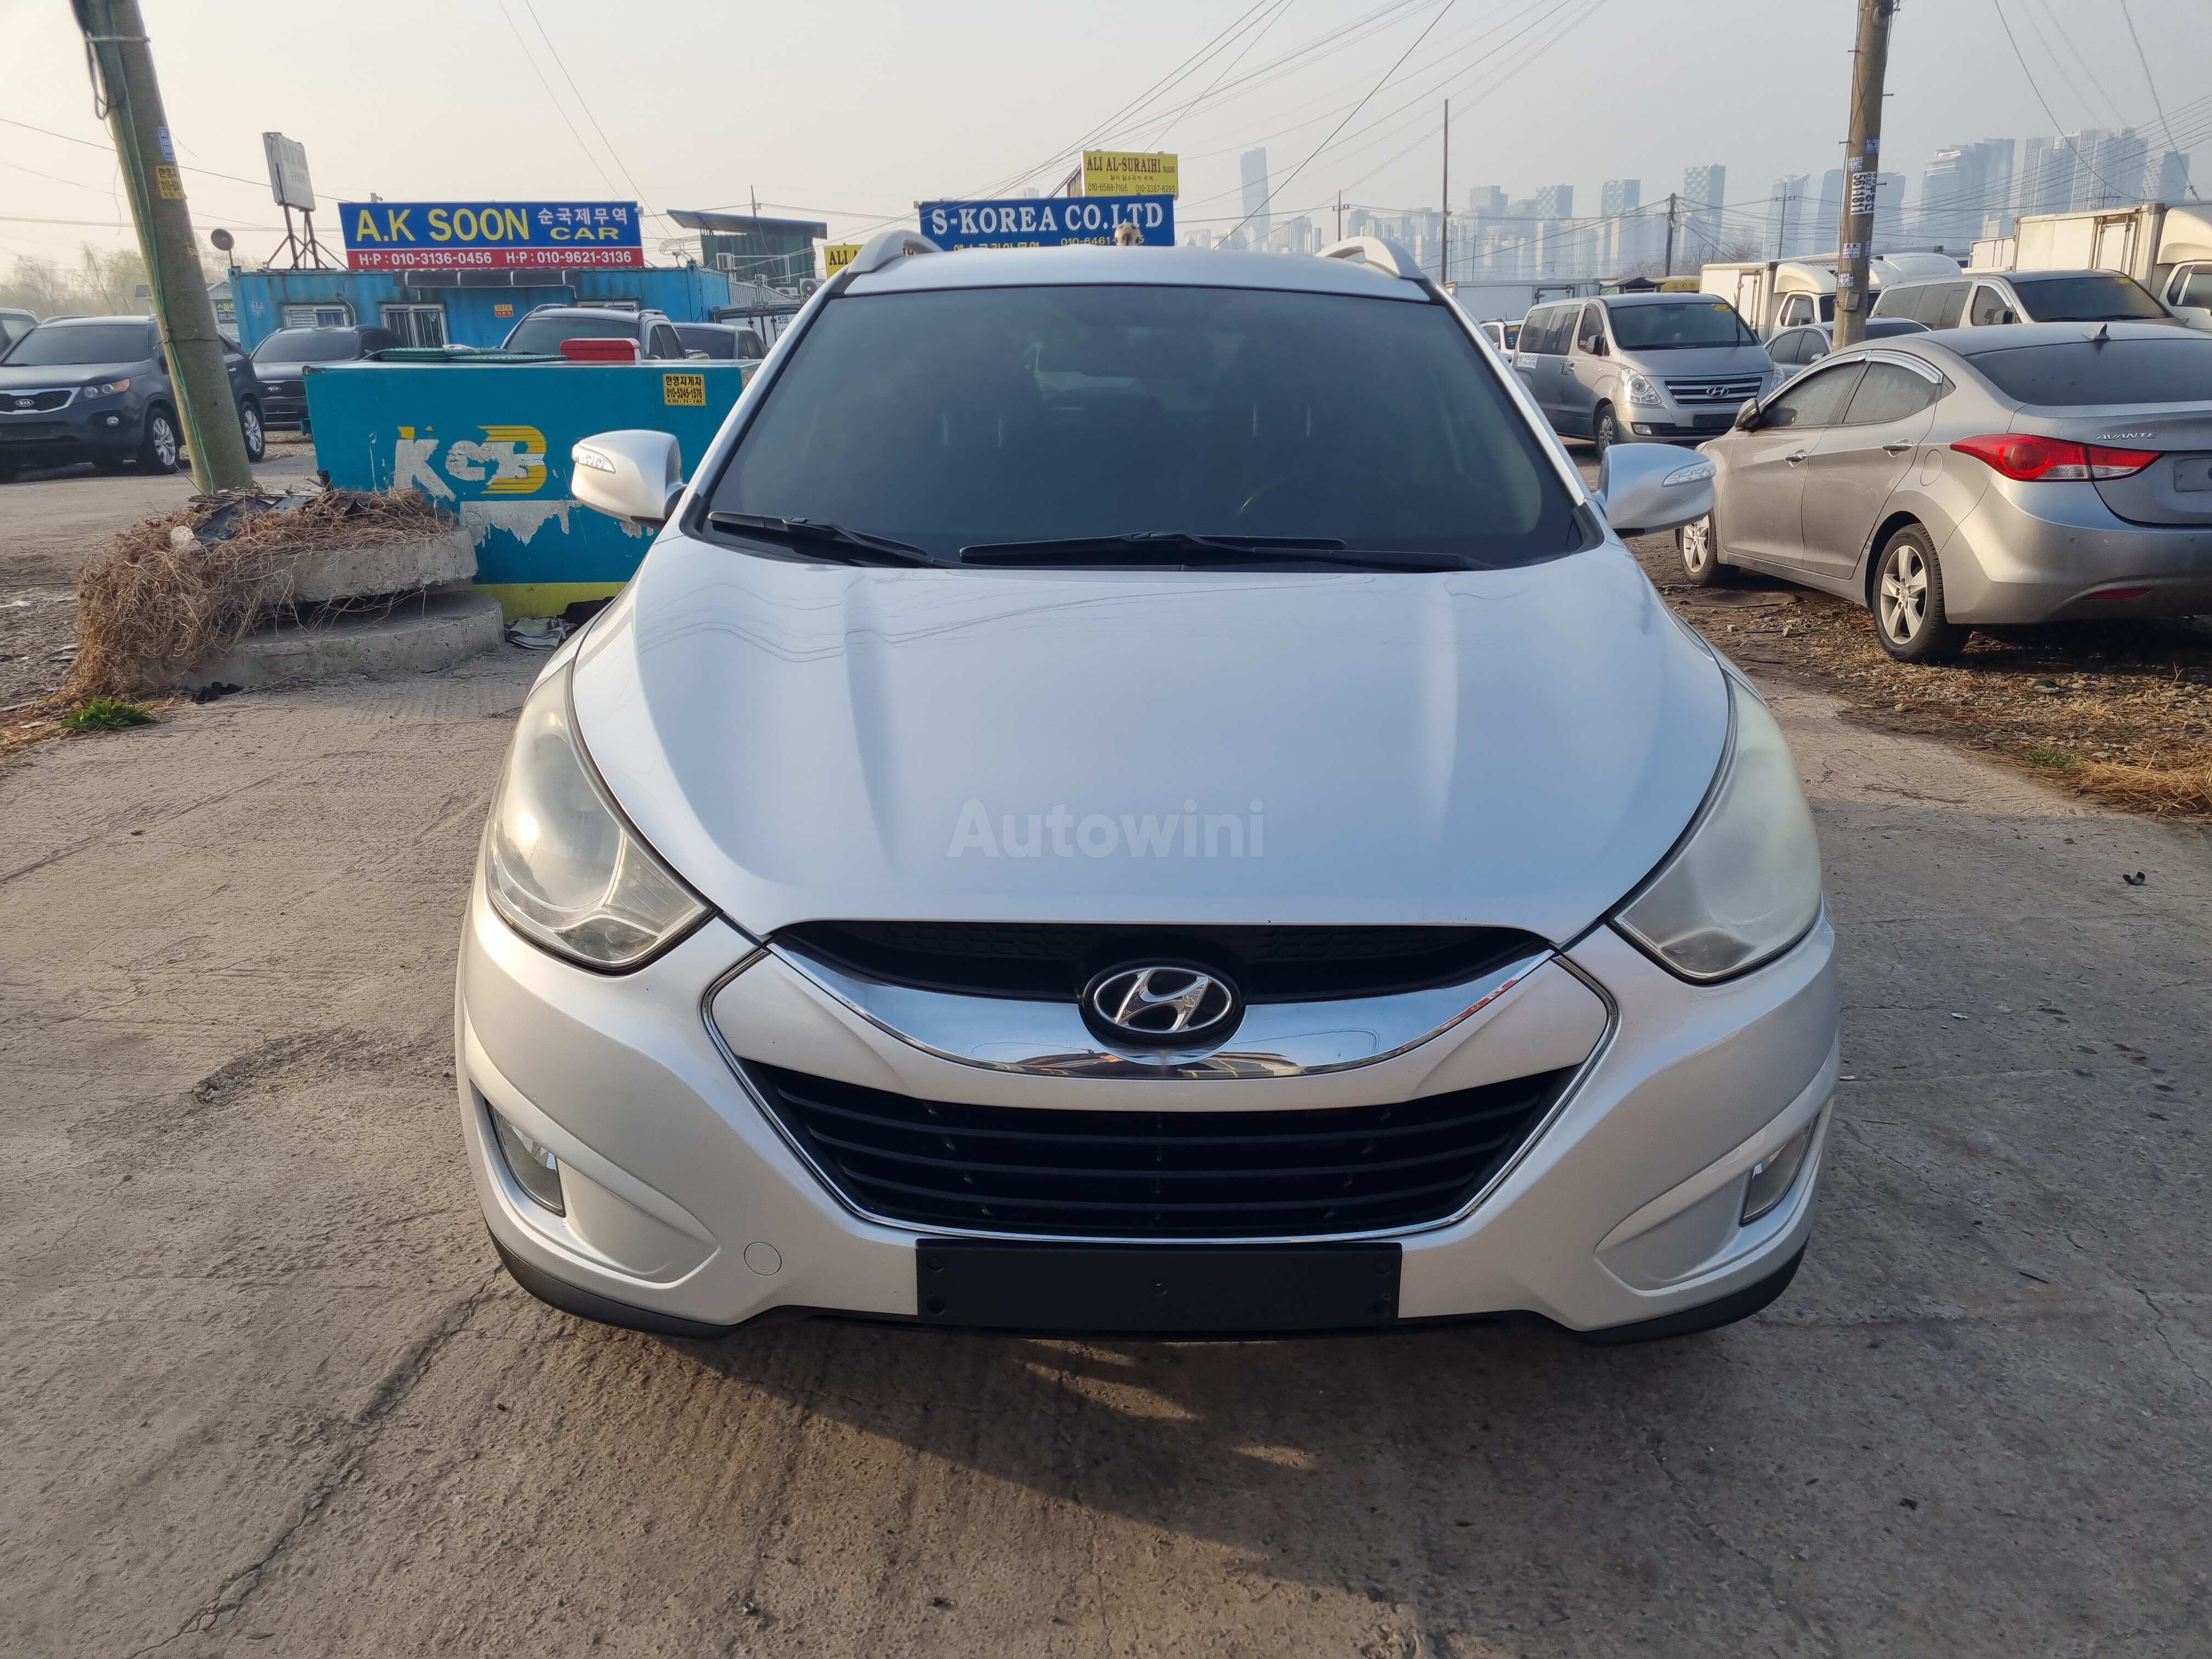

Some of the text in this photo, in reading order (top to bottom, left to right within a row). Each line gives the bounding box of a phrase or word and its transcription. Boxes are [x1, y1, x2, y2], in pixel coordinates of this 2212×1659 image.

[1087, 156, 1103, 171] ALI
[1106, 157, 1161, 173] AL-SURAIHI
[538, 207, 627, 225] 순국제무역
[932, 202, 1163, 234] S-KOREA CO.LTD
[357, 208, 530, 241] A.K SOON
[550, 227, 619, 240] CAR
[392, 252, 492, 265] 010-3136-0456
[537, 251, 631, 263] 010-9621-3136
[830, 250, 848, 265] ALI
[665, 376, 702, 386] 한영지게차
[666, 388, 702, 398] 010-5245-1576
[2094, 432, 2159, 441] AVANTE
